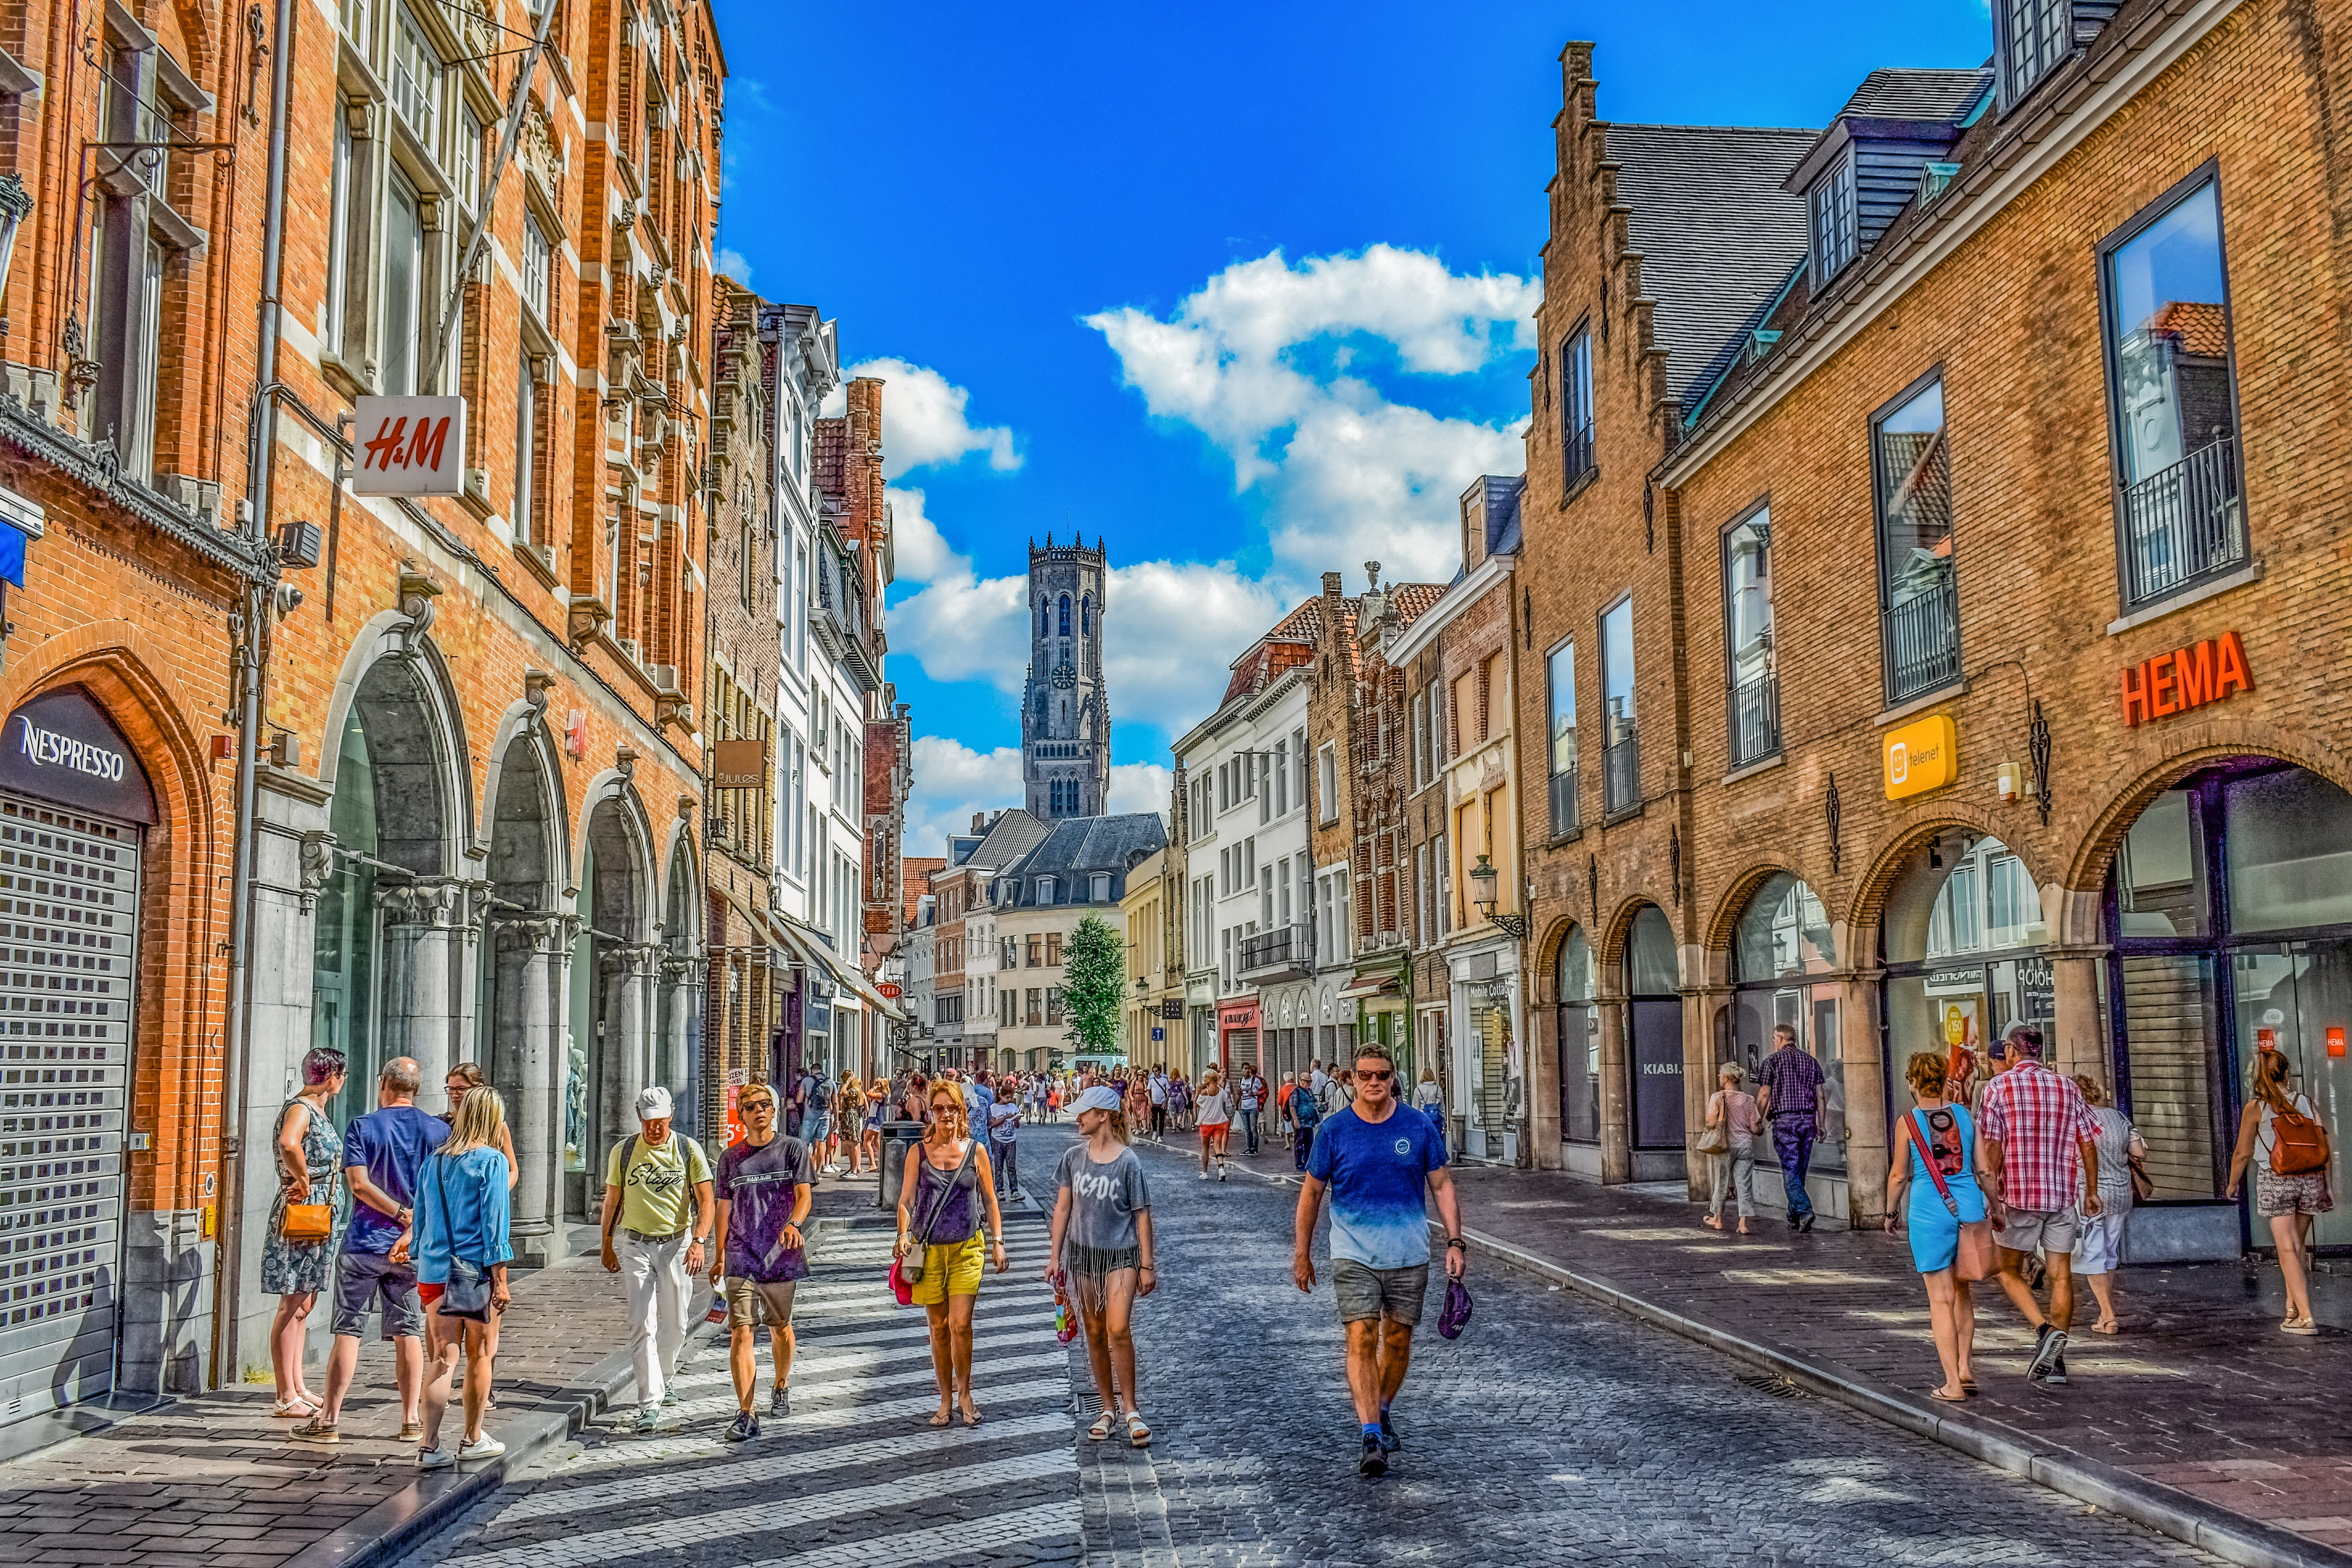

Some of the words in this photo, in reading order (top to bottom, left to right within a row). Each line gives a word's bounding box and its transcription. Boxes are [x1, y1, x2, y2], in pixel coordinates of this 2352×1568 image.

[364, 416, 451, 472] H&M
[2122, 631, 2255, 727] HEMA
[1909, 743, 1939, 767] telenet
[1470, 985, 1488, 998] Mobile
[1489, 983, 1512, 998] Cottage
